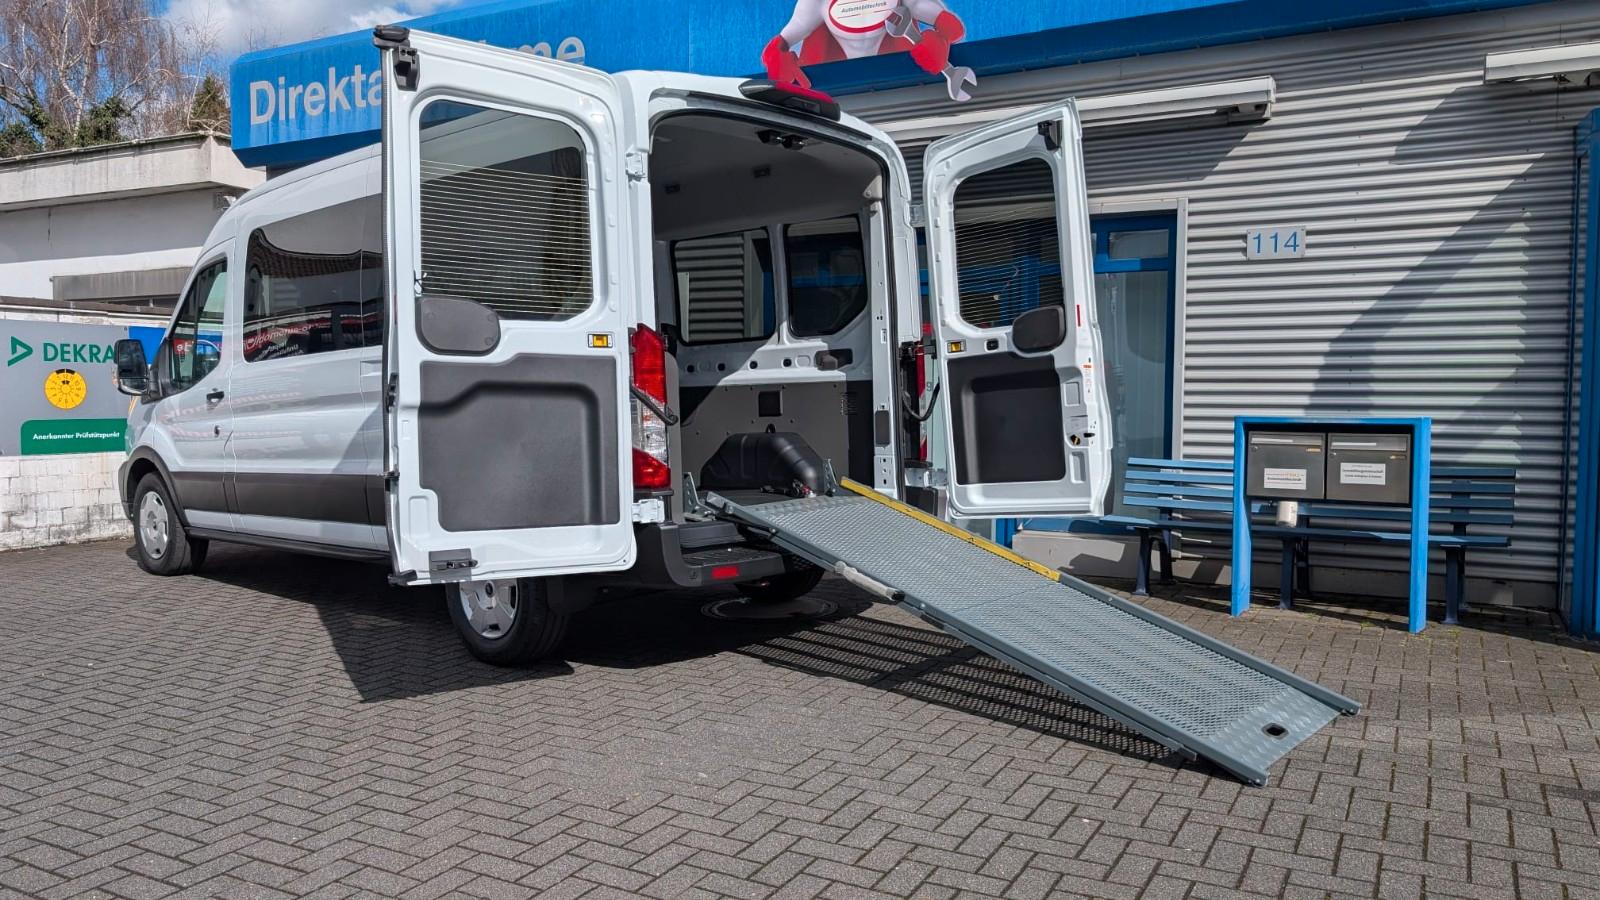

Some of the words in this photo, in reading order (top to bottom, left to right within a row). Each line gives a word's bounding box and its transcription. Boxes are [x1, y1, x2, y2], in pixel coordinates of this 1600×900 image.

[1252, 231, 1300, 254] 114
[43, 342, 115, 363] DEKRA
[75, 431, 120, 439] Prüfstützpunkt
